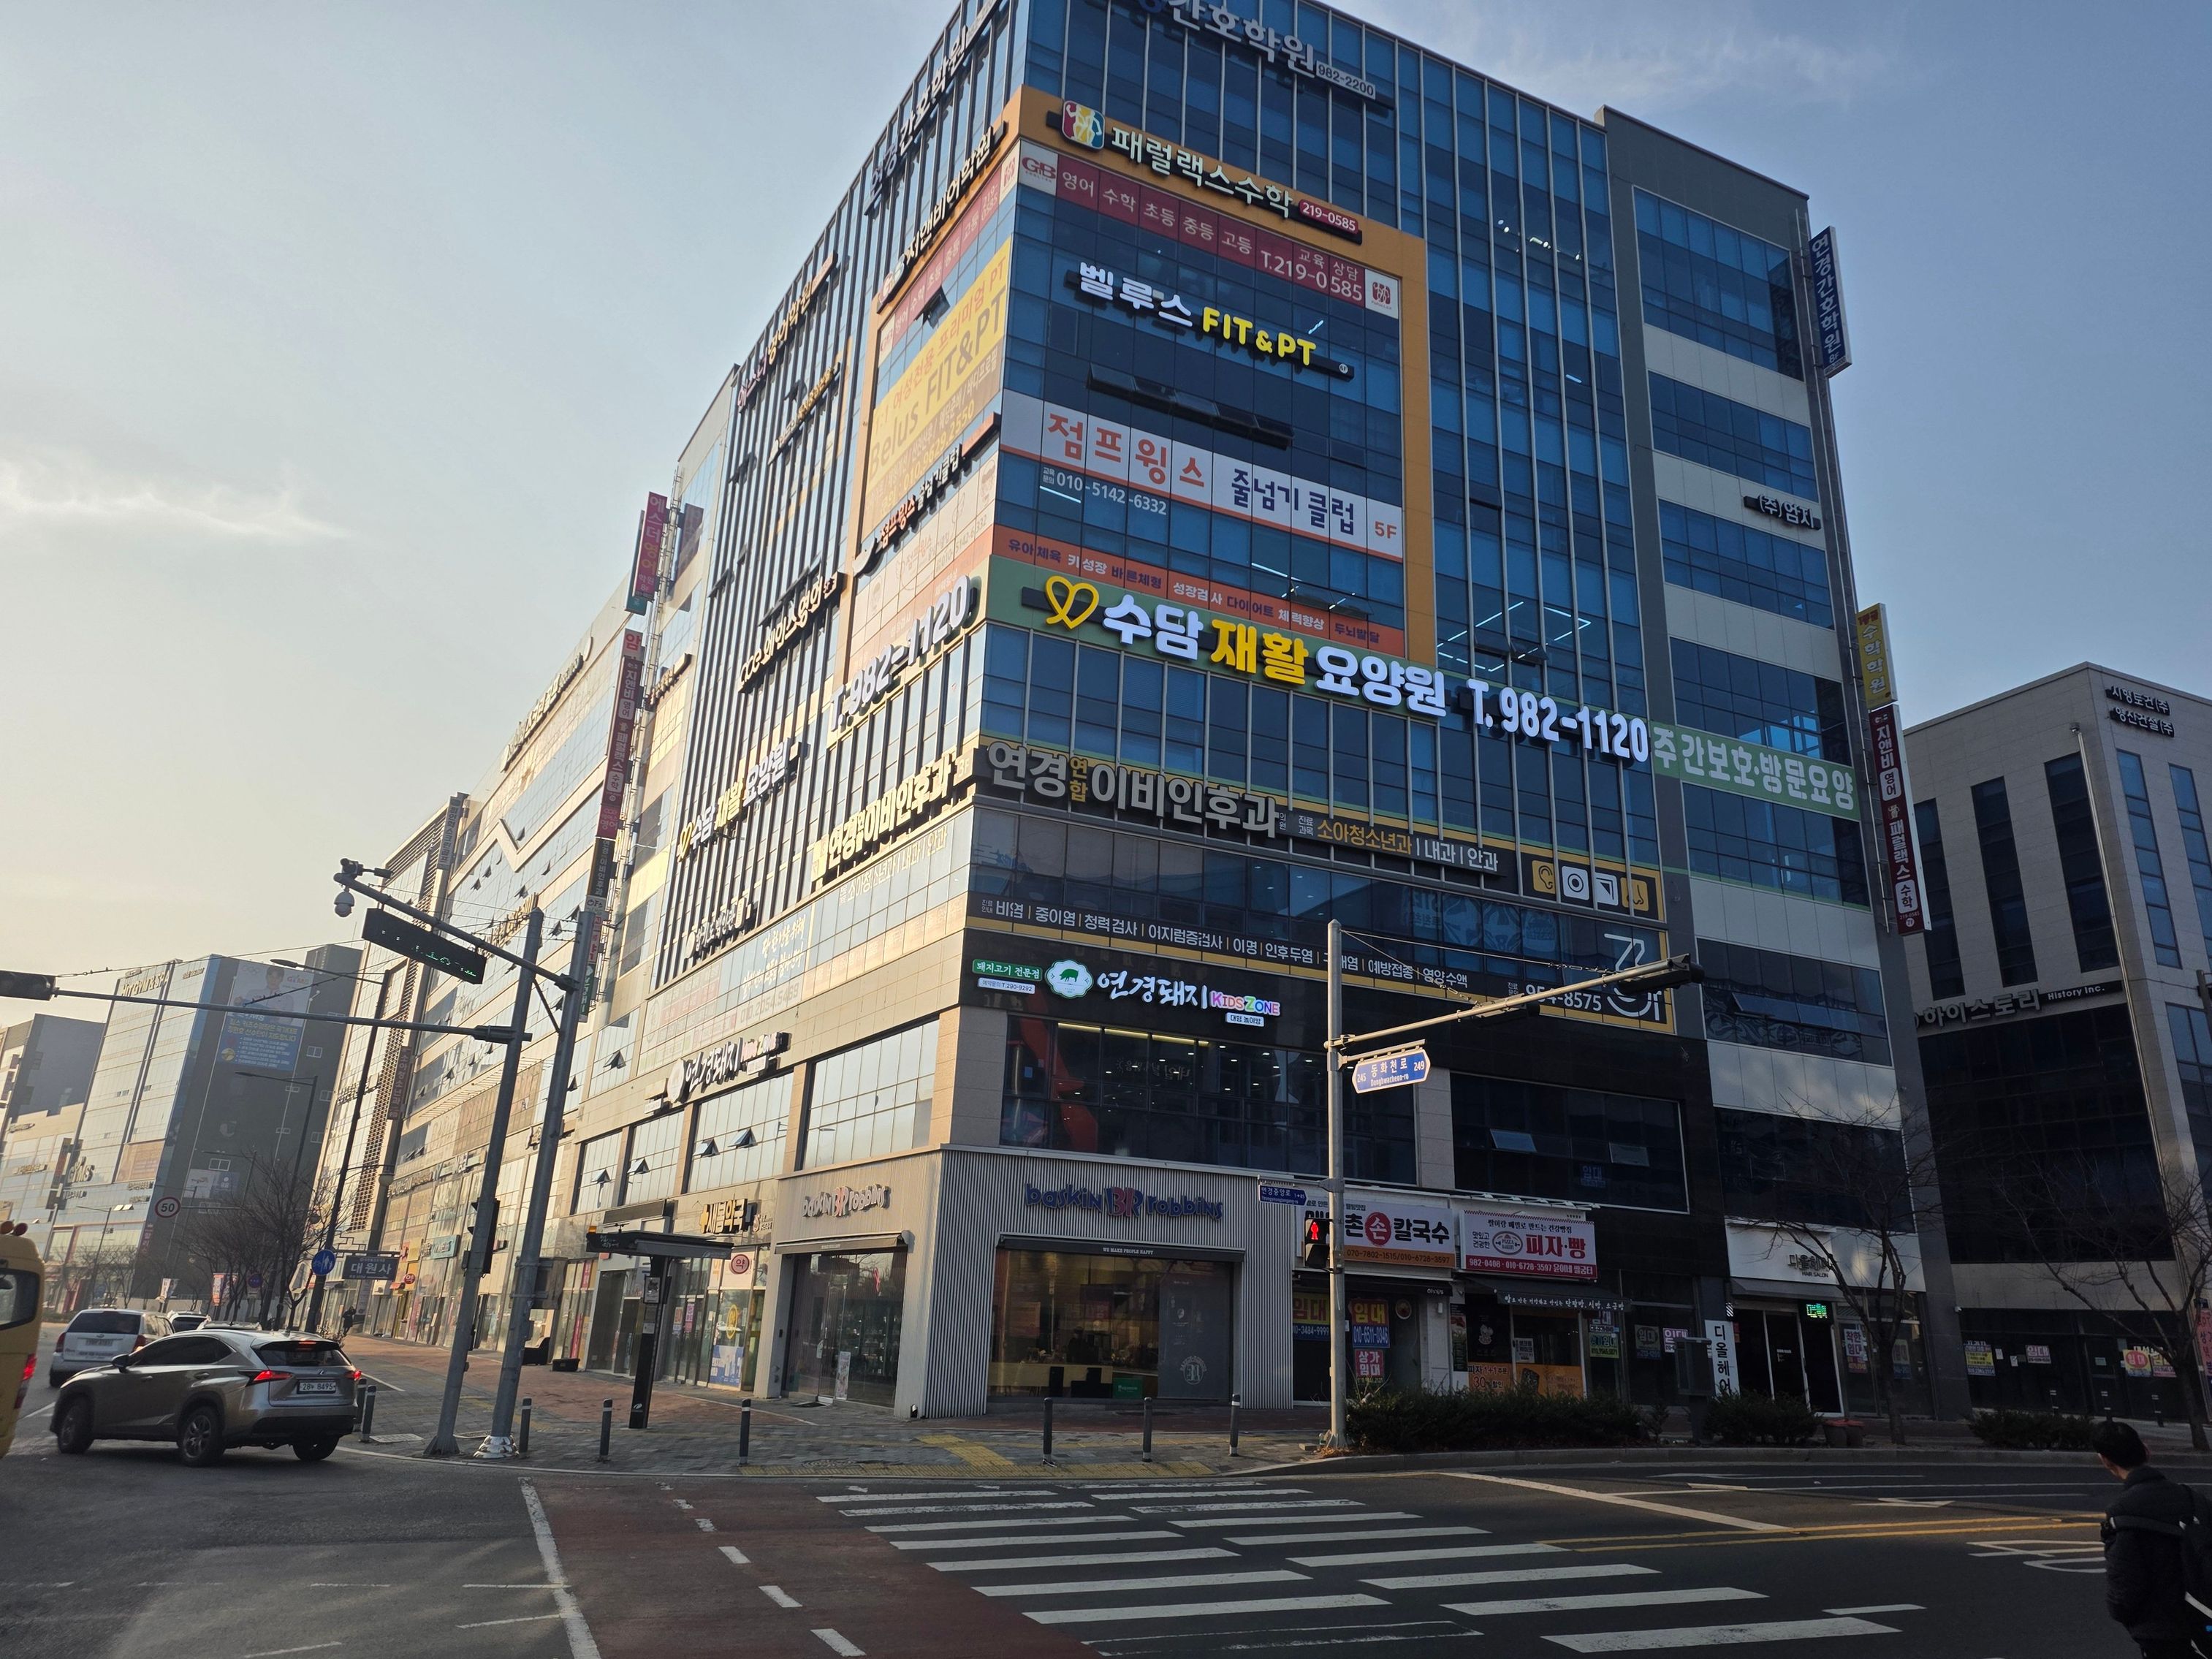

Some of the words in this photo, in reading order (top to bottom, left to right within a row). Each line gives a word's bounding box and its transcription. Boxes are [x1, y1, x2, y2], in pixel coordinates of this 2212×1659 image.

[1139, 0, 1315, 78] 간호학원
[1318, 63, 1374, 98] 982-2200
[1111, 126, 1293, 219] 패럴랙스수학
[1302, 202, 1356, 232] 219-0585
[1063, 172, 1095, 197] 영어
[1103, 189, 1137, 213] 수학
[1144, 203, 1176, 227] 초등
[1183, 216, 1215, 241] 중등
[1222, 231, 1253, 255] 고등
[1261, 250, 1363, 301] T.219-0585
[1299, 249, 1326, 269] 교육
[1334, 262, 1359, 281] 상담
[938, 292, 985, 349] 프리미엄
[989, 255, 1006, 292] PT
[1079, 262, 1193, 327] 벨루스
[1812, 233, 1841, 353] 연경간호학원
[1047, 412, 1205, 487] 점프윙스
[1231, 468, 1299, 511] 줄넘기
[1308, 491, 1354, 536] 클럽
[1375, 522, 1397, 539] 5F
[1056, 472, 1167, 516] 010-5142-6332
[1008, 539, 1062, 563] 유아체육
[1068, 554, 1107, 574] 키성장
[1111, 566, 1162, 591] 바른체형
[1173, 582, 1223, 605] 성장검사
[1227, 596, 1274, 618] 다이어트
[1278, 609, 1324, 631] 체력향상
[1334, 623, 1380, 644] 두뇌발달
[626, 634, 642, 651] 암
[1103, 594, 1204, 660] 수담
[1209, 618, 1310, 686] 재활
[1315, 645, 1447, 718] 요양원
[1877, 726, 1896, 769] 지앤비
[989, 741, 1067, 798] 연경
[1070, 756, 1089, 802] 연합
[1091, 764, 1280, 838] 이비인후과
[1883, 771, 1897, 797] 영어
[1299, 814, 1314, 825] 진료
[1299, 824, 1314, 837] 과목
[1317, 819, 1413, 855] 소아청소년과
[1424, 841, 1456, 864] 내과
[1467, 849, 1499, 872] 안과
[1889, 820, 1911, 880] 패럴랙스
[981, 906, 993, 914] 안내
[1901, 884, 1913, 908] 수학
[995, 900, 1024, 919] 비염
[1035, 907, 1076, 927] 중이염
[1148, 923, 1223, 949] 어지럼증검사
[1233, 938, 1258, 956] 이명
[1265, 942, 1313, 965] 인후두염
[1368, 958, 1413, 982] 예방접종
[1423, 967, 1467, 988] 영양수액
[976, 962, 1011, 977] 돼지고기
[1015, 966, 1041, 981] 전문점
[1097, 970, 1208, 1009] 연경돼지
[2085, 985, 2105, 995] Inc.
[1230, 1015, 1243, 1023] 대형
[1244, 1016, 1261, 1025] 놀이방
[160, 1201, 176, 1214] 50
[1025, 1183, 1103, 1212] baskin
[1147, 1195, 1223, 1220] robbins
[1261, 1187, 1291, 1196] 연경중앙로
[1369, 1216, 1388, 1240] 손
[1394, 1218, 1450, 1244] 칼국수
[1472, 1231, 1490, 1240] 맛있고
[351, 1263, 392, 1275] 대원사
[1355, 1303, 1386, 1324] 임대
[1358, 1351, 1380, 1363] 상가
[2027, 1345, 2049, 1356] 임대
[1359, 1364, 1380, 1376] 임대
